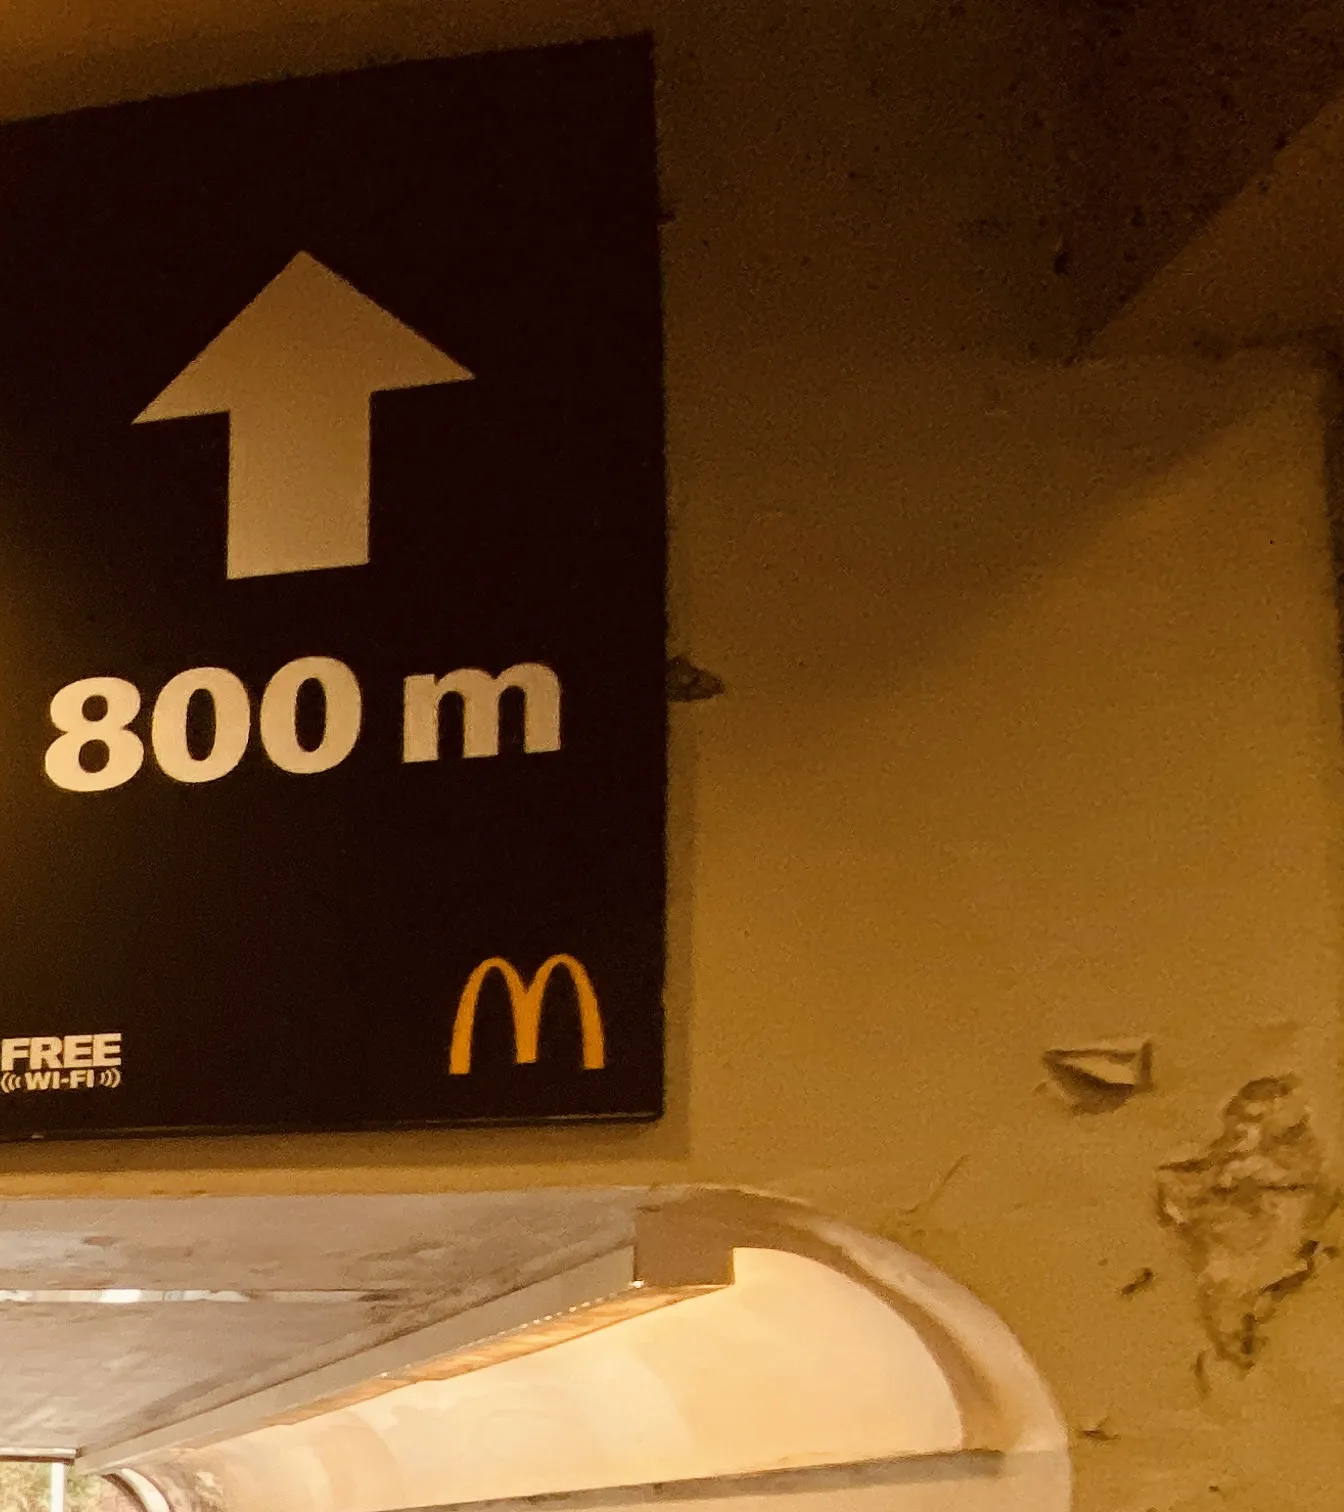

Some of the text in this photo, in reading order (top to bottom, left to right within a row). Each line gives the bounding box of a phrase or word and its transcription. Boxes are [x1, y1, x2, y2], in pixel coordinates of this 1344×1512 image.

[43, 655, 563, 792] 800 m
[1, 1033, 121, 1071] FREE
[449, 953, 605, 1076] M
[24, 1069, 95, 1091] WI-FI
